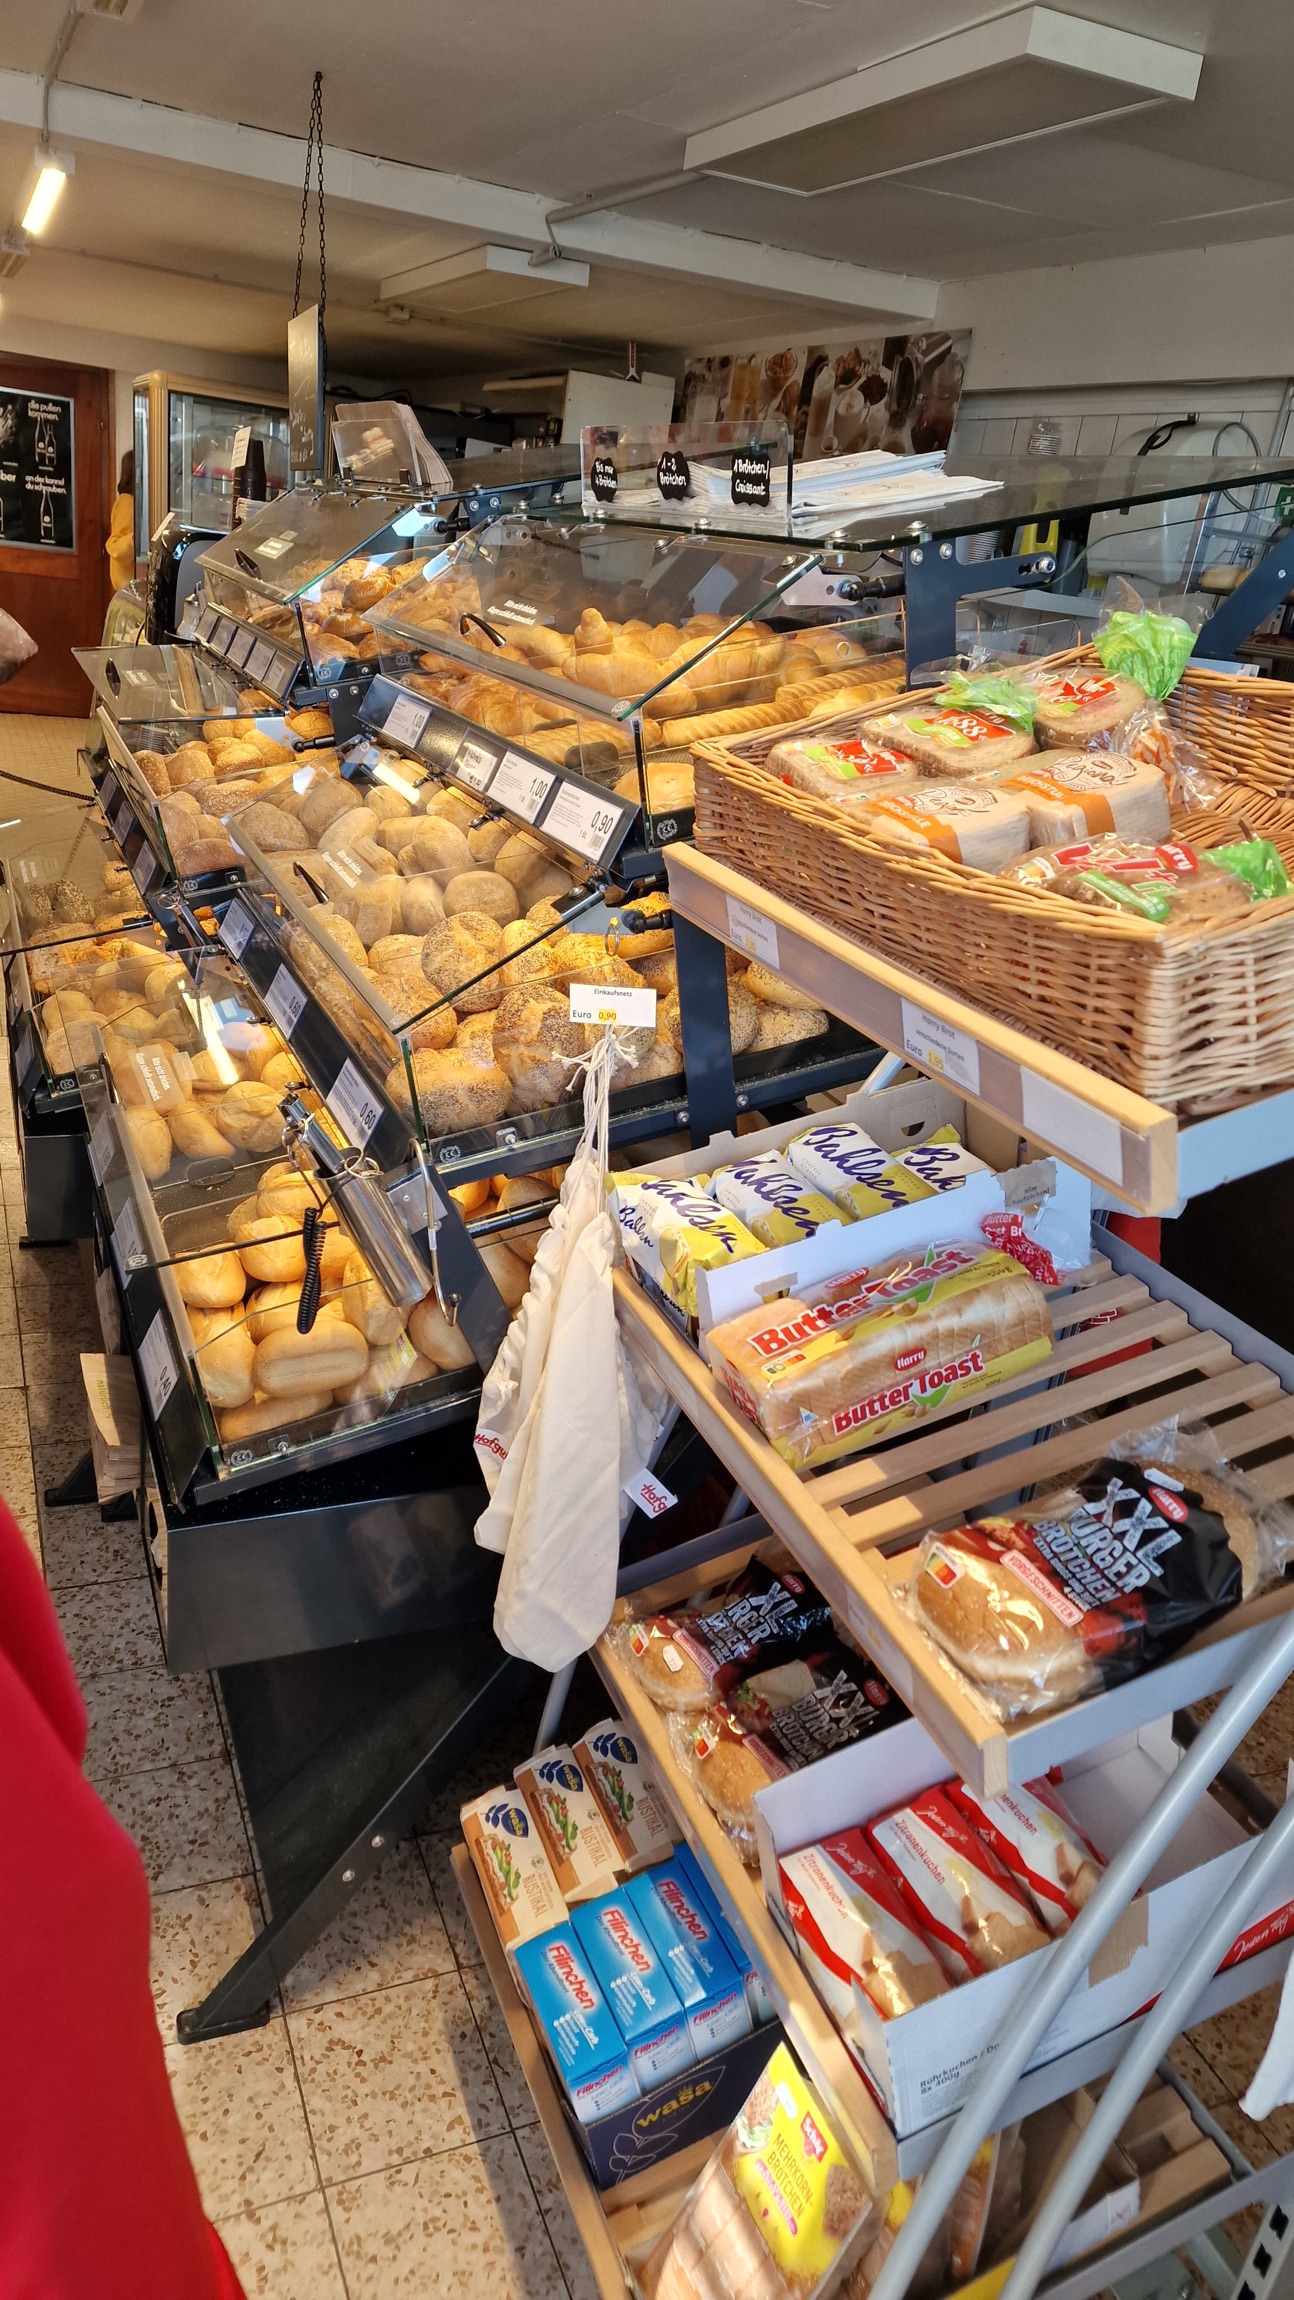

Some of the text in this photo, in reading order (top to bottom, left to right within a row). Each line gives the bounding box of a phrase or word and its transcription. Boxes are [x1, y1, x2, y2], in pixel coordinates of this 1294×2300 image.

[40, 402, 62, 414] pullen
[660, 472, 687, 487] Brötchen
[735, 479, 766, 496] Croissant
[528, 778, 549, 799] 1,00
[591, 811, 614, 836] 0,90
[731, 928, 743, 943] Euro
[594, 988, 632, 997] Einkaufsnetz
[573, 1009, 617, 1021] Euro 0,90
[922, 1013, 956, 1040] Harry Brot
[906, 1039, 923, 1058] Euro
[360, 1102, 377, 1131] 0,60
[803, 1127, 910, 1208] Bahlsen
[1025, 1185, 1038, 1195] Hier
[985, 1213, 1014, 1226] Butter
[828, 1268, 867, 1287] Harry
[749, 1297, 870, 1358] Butter
[863, 1249, 976, 1298] Toast
[896, 1351, 926, 1370] Harry
[160, 1366, 172, 1397] 0,40
[832, 1383, 915, 1436] Butter
[913, 1350, 985, 1390] Toast
[641, 1484, 668, 1514] Hofg
[1152, 1488, 1186, 1521] Harry
[1084, 1477, 1182, 1577] XXL
[1034, 1537, 1051, 1563] EXTRA
[1034, 1520, 1121, 1603] BRÖTCHEN
[783, 1575, 803, 1595] Harry
[1008, 1554, 1077, 1620] VORGESCHNITTEN
[728, 1596, 770, 1646] RGER
[748, 1581, 798, 1635] XL
[814, 1669, 880, 1738] XX
[616, 1737, 633, 1764] wasa
[562, 1765, 579, 1793] wasa
[509, 1807, 525, 1838] wasa
[635, 1797, 665, 1838] RUSTIKAL
[579, 1826, 607, 1868] RUSTIKAL
[895, 1819, 946, 1886] Zitronenkuchen
[521, 1875, 549, 1919] RUSTIKAL
[658, 1880, 708, 1942] Filinchen
[602, 1909, 651, 1973] Filinchen
[604, 1926, 625, 1957] Abendbrot
[547, 1944, 595, 2011] Filinchen
[548, 1963, 570, 1994] Abendbrot
[694, 1992, 738, 2025] Filinchen
[634, 2025, 679, 2058] Filinchen
[576, 2063, 622, 2098] Filinchen
[920, 2055, 979, 2089] Rührkuchen
[921, 2070, 961, 2096] 8x 400g
[637, 2080, 713, 2129] wasa
[803, 2116, 824, 2155] Schär
[768, 2151, 806, 2220] BRÖTCHEN
[773, 2134, 814, 2208] MEHRKORN-
